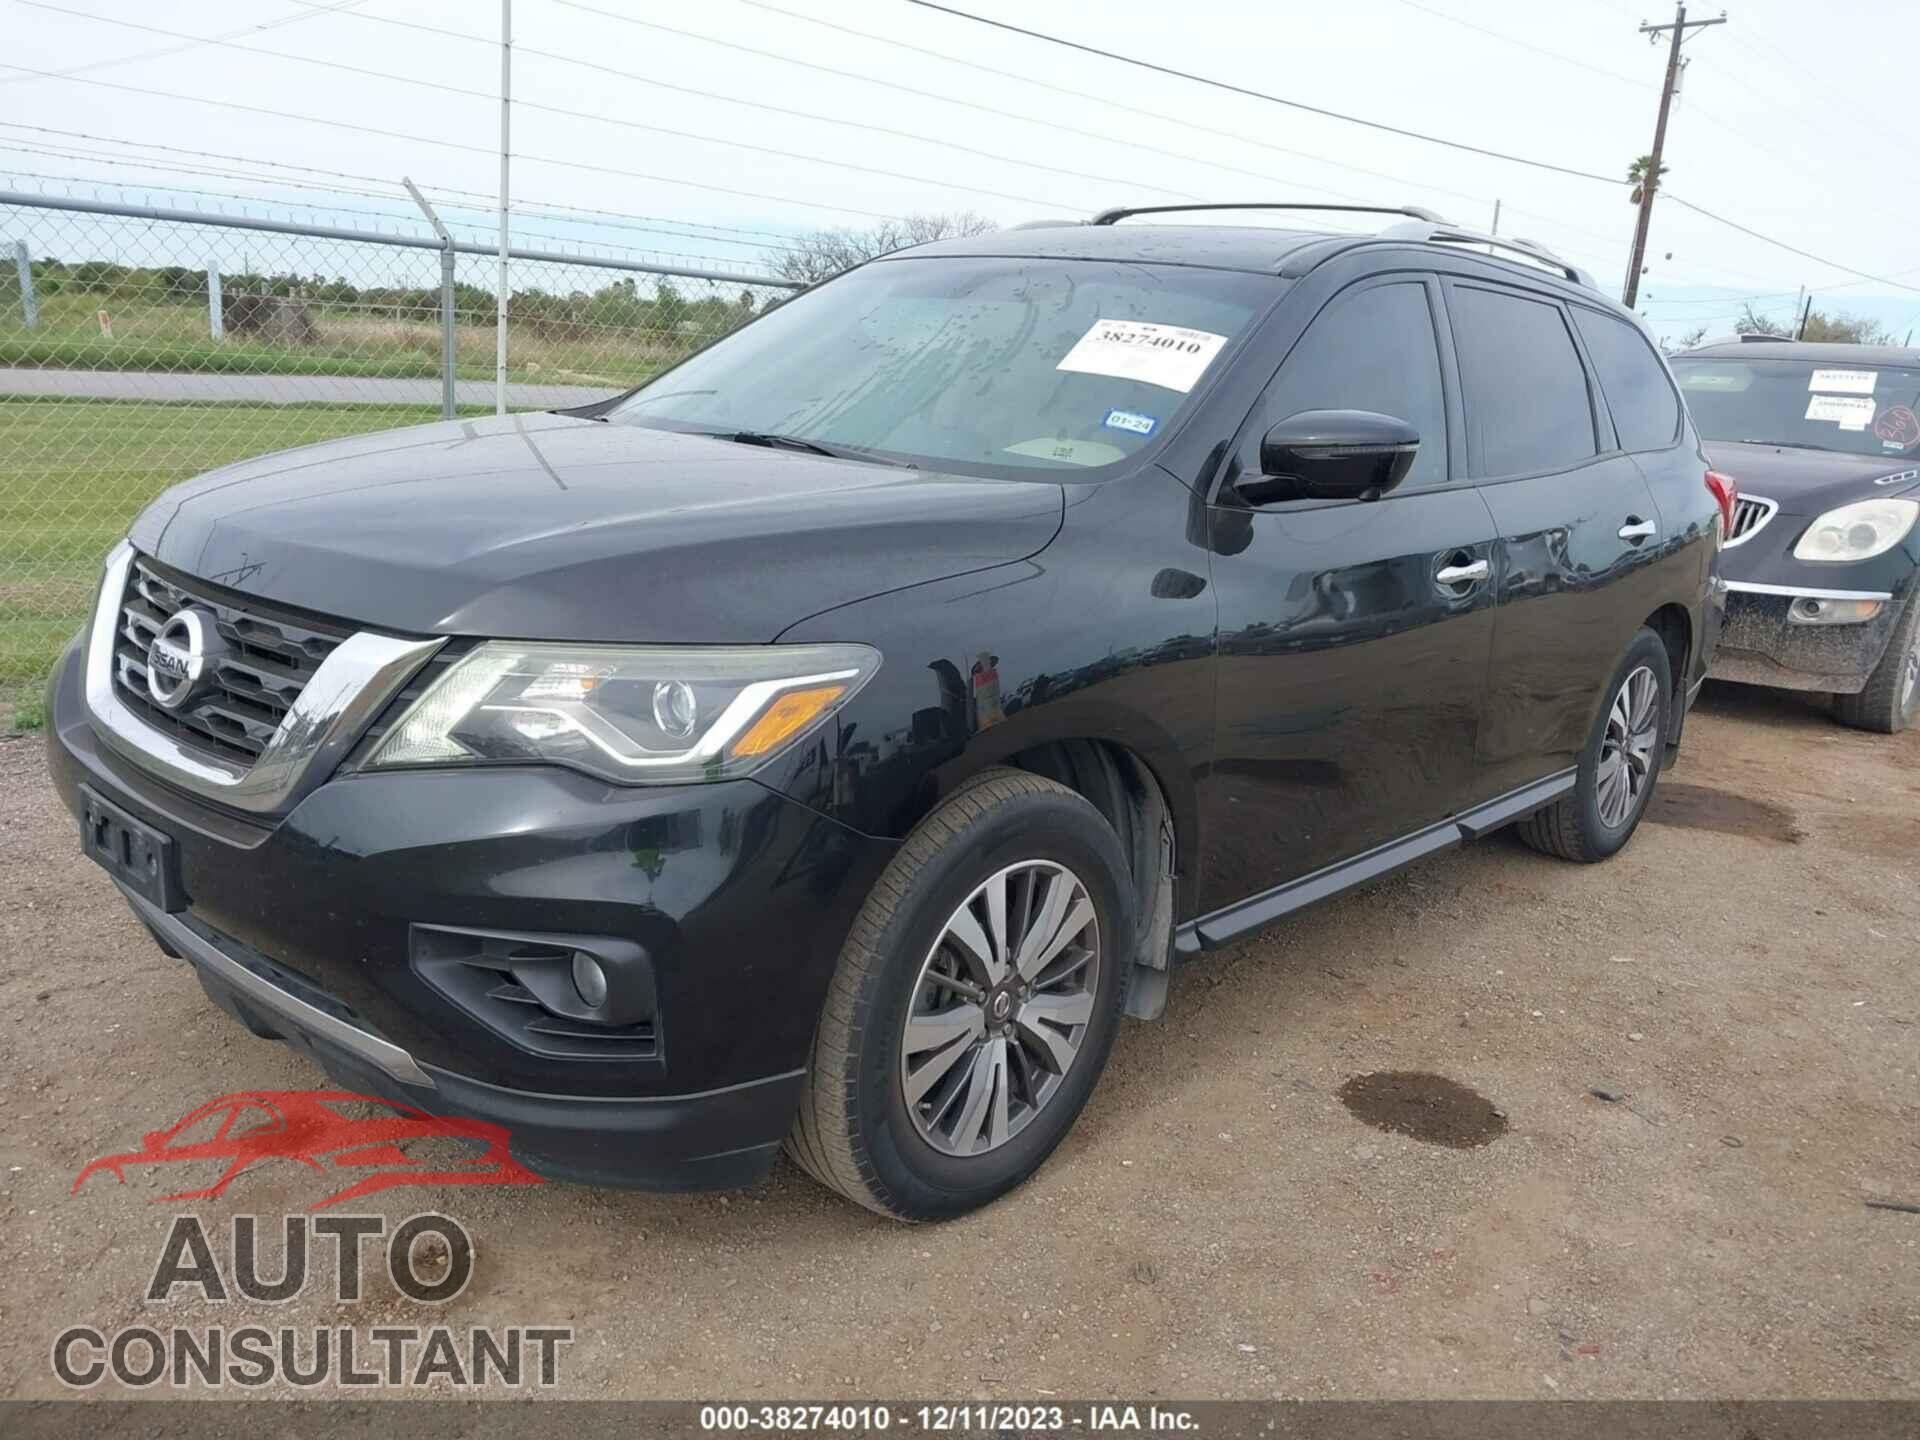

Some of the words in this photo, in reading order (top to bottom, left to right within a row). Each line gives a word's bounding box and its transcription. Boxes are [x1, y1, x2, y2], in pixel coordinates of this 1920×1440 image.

[1101, 330, 1201, 354] 38274010
[1110, 414, 1150, 431] 01-24
[150, 652, 190, 674] SSAN
